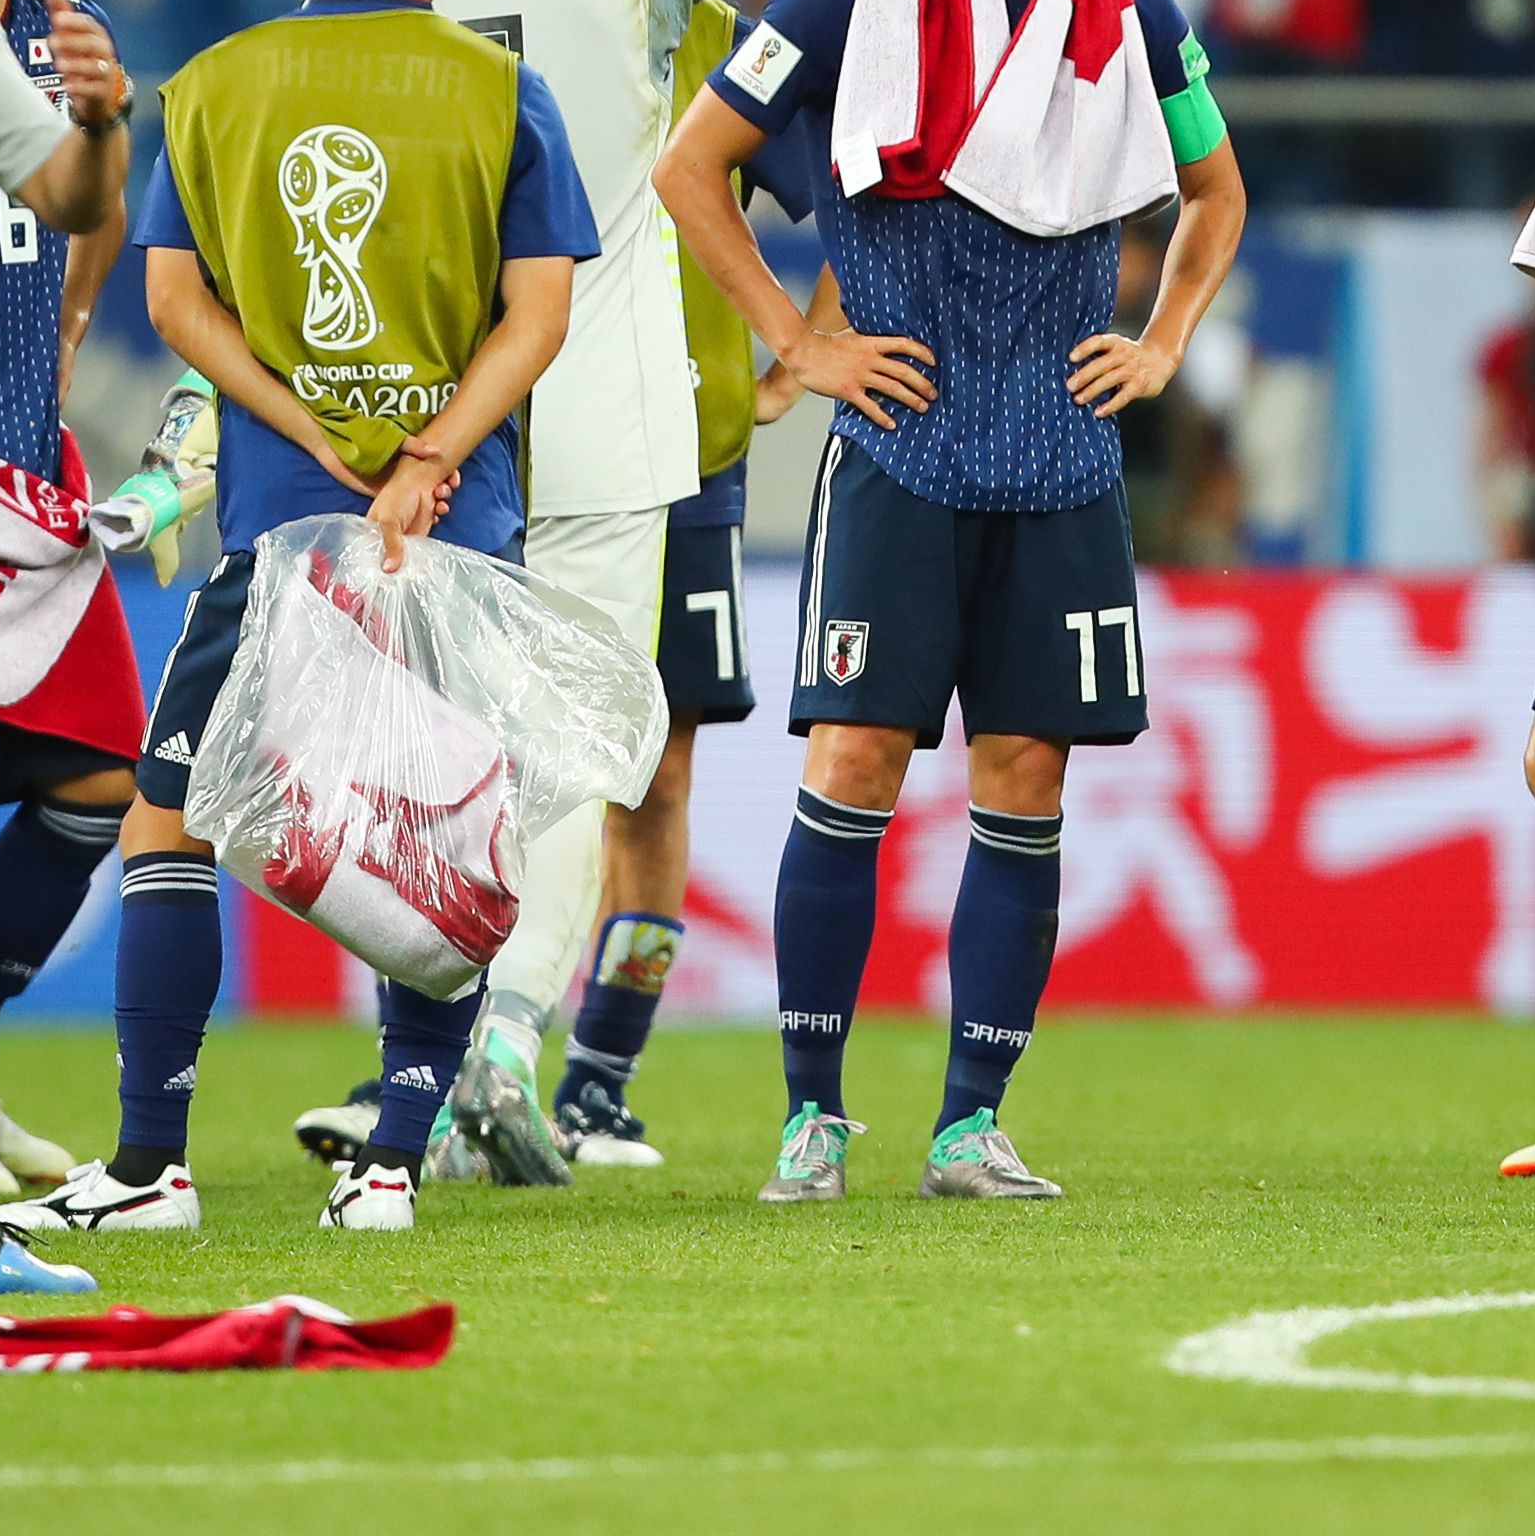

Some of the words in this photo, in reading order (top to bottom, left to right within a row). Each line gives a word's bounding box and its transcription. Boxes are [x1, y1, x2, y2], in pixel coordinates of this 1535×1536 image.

[378, 364, 413, 381] CUP
[1066, 605, 1147, 703] 17
[154, 747, 195, 766] adidas
[963, 1020, 1032, 1049] JAPAN
[390, 1075, 439, 1094] adidas
